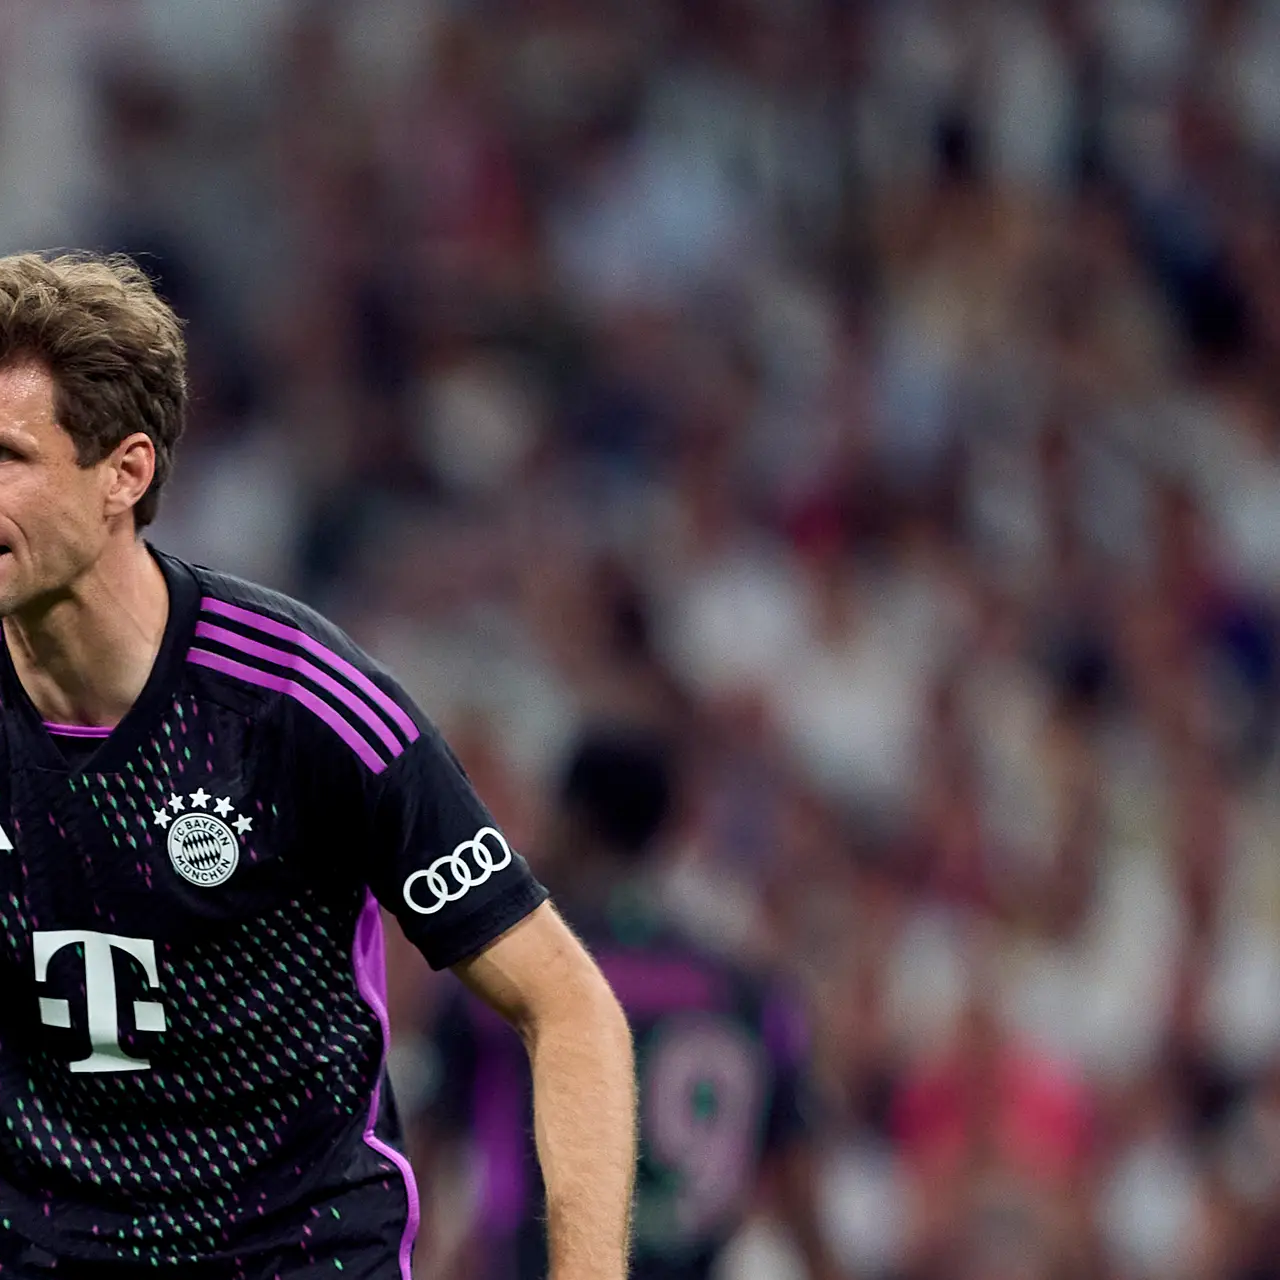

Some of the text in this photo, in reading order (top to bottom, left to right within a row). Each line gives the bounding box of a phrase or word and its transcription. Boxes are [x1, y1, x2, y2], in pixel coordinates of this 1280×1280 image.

[174, 819, 231, 847] FC BAYERN
[175, 855, 231, 882] MÜNCHEN
[32, 930, 166, 1073] T
